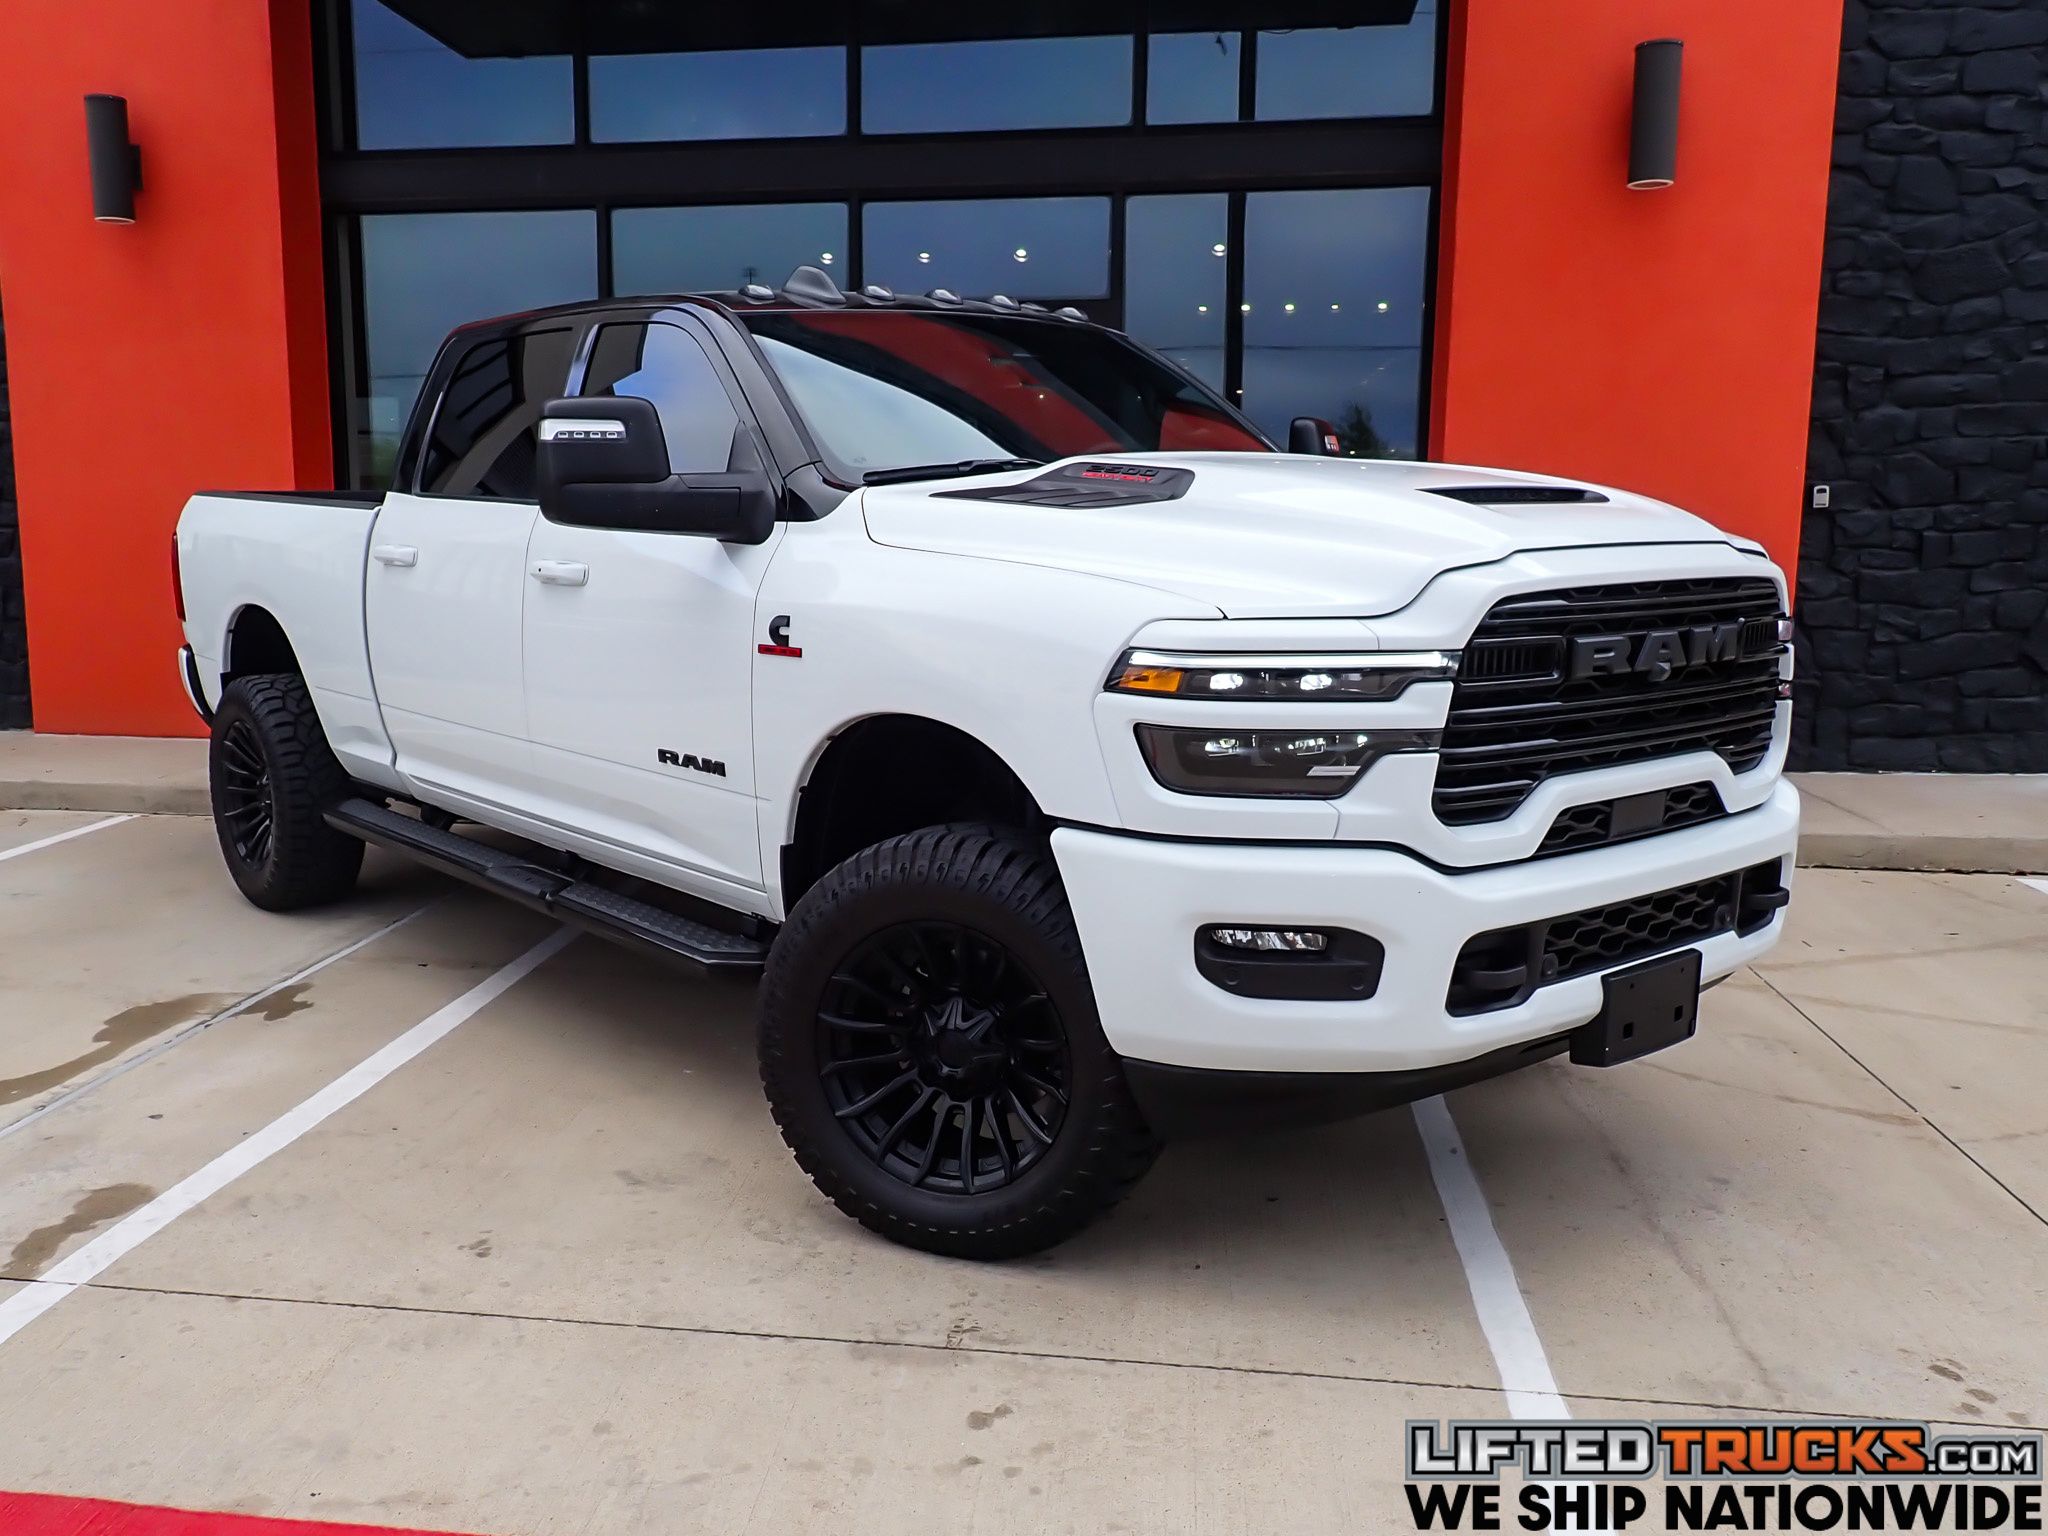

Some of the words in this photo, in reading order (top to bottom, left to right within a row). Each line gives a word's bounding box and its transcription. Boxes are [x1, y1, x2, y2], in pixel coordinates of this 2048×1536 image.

[1086, 465, 1160, 477] 2500
[1572, 622, 1740, 678] RAM
[657, 748, 727, 777] RAM
